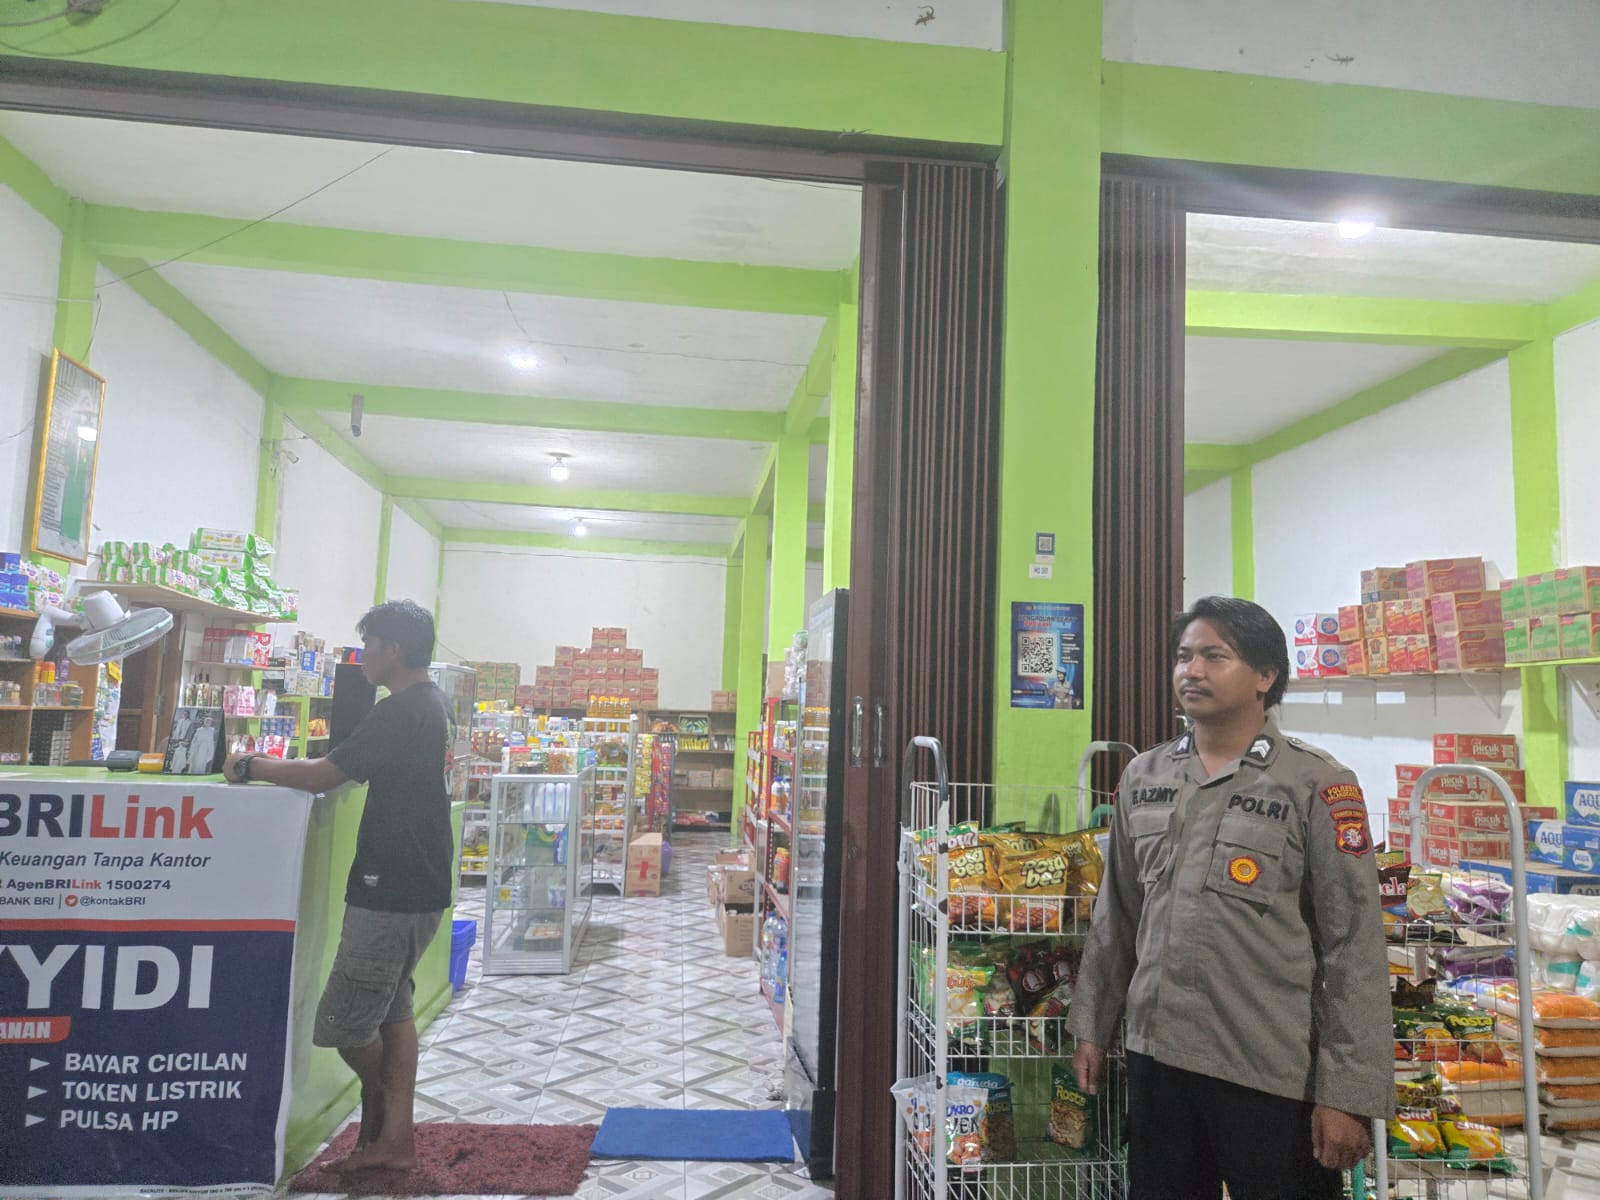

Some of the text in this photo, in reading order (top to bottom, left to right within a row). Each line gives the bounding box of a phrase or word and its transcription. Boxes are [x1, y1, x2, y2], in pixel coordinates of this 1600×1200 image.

[0, 794, 215, 839] BRILink
[1228, 794, 1290, 820] POLRI
[0, 851, 211, 870] Keuangan Tanpa Kantor
[7, 879, 171, 891] AgenBRILink 1500274
[1379, 876, 1408, 896] ela
[34, 897, 54, 905] BRI
[80, 896, 146, 906] @kontakBRI
[0, 945, 214, 1010] YIDI
[65, 1053, 248, 1074] BAYAR CICILAN
[62, 1081, 242, 1103] TOKEN LISTRIK
[60, 1109, 179, 1131] PULSA HP
